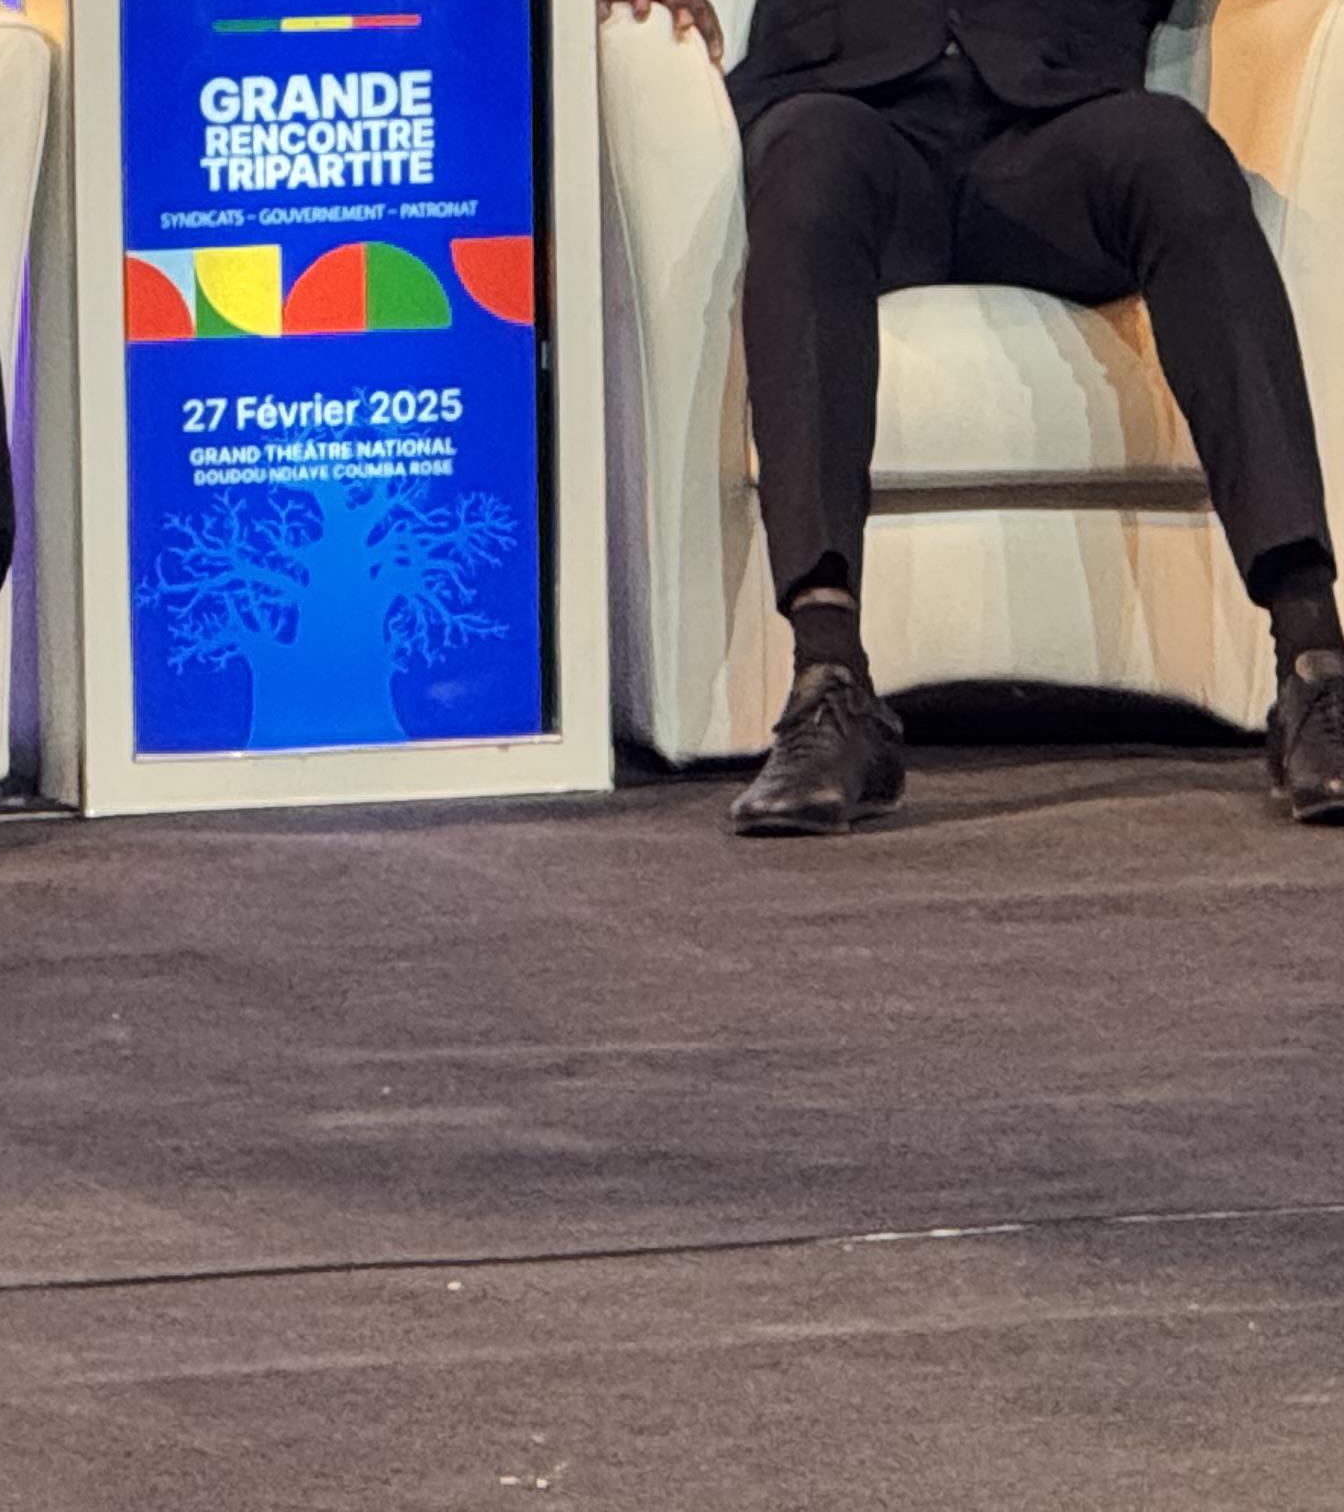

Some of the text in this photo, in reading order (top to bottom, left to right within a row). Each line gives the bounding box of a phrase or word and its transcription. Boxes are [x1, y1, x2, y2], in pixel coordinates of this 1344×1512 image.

[199, 70, 434, 125] GRANDE
[205, 116, 434, 158] RENCONTRE
[200, 149, 434, 191] TRIPARTITE
[160, 209, 245, 229] SYNDICATS
[258, 203, 386, 225] GOUVERNEMENT
[399, 199, 478, 218] PATRONAT
[183, 388, 463, 432] 27 Février 2025
[189, 445, 261, 466] GRAND
[356, 437, 456, 458] NATIONAL
